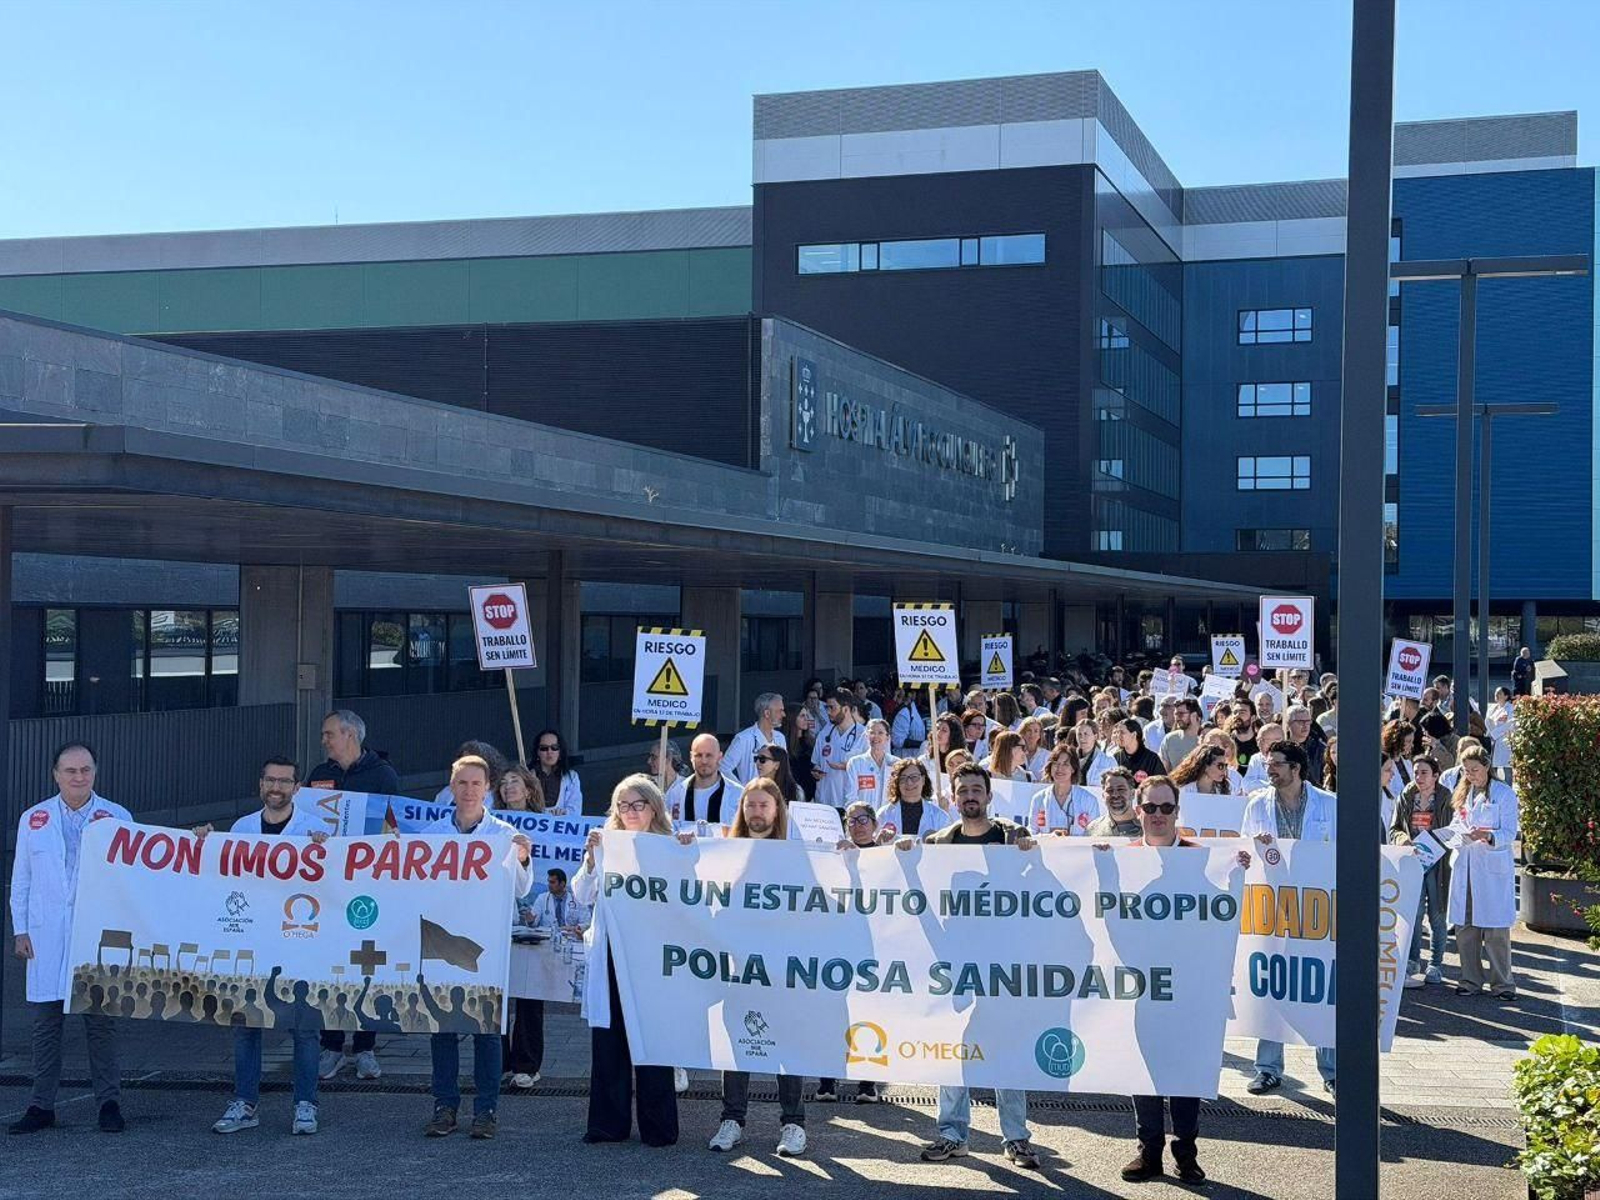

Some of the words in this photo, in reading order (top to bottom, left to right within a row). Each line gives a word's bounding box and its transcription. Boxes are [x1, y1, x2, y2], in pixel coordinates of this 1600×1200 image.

[484, 605, 515, 619] STOP
[901, 615, 947, 627] RIESGO
[1272, 613, 1301, 626] STOP
[482, 635, 527, 647] TRABALLO
[985, 641, 1008, 650] RIESGO
[1265, 639, 1308, 650] TRABALLO
[485, 650, 501, 660] SEN
[644, 641, 696, 656] RIESGO
[1266, 652, 1281, 661] SEN
[1282, 651, 1307, 662] LÍMITE
[1399, 653, 1421, 665] STOP
[404, 805, 422, 821] SI
[553, 820, 580, 836] EN
[106, 826, 206, 876] NON
[219, 839, 327, 882] IMOS
[344, 840, 493, 881] PARAR
[555, 846, 587, 862] ME
[604, 872, 668, 903] POR
[679, 879, 731, 908] UN
[743, 883, 926, 915] ESTATUTO
[939, 882, 1081, 918] MÉDICO
[1095, 891, 1237, 922] PROPIO
[1240, 884, 1336, 941] IDAD
[662, 944, 772, 987] POLA
[786, 955, 912, 994] NOSA
[928, 961, 1174, 1001] SANIDADE
[738, 1038, 776, 1046] ASOCIACIÓN
